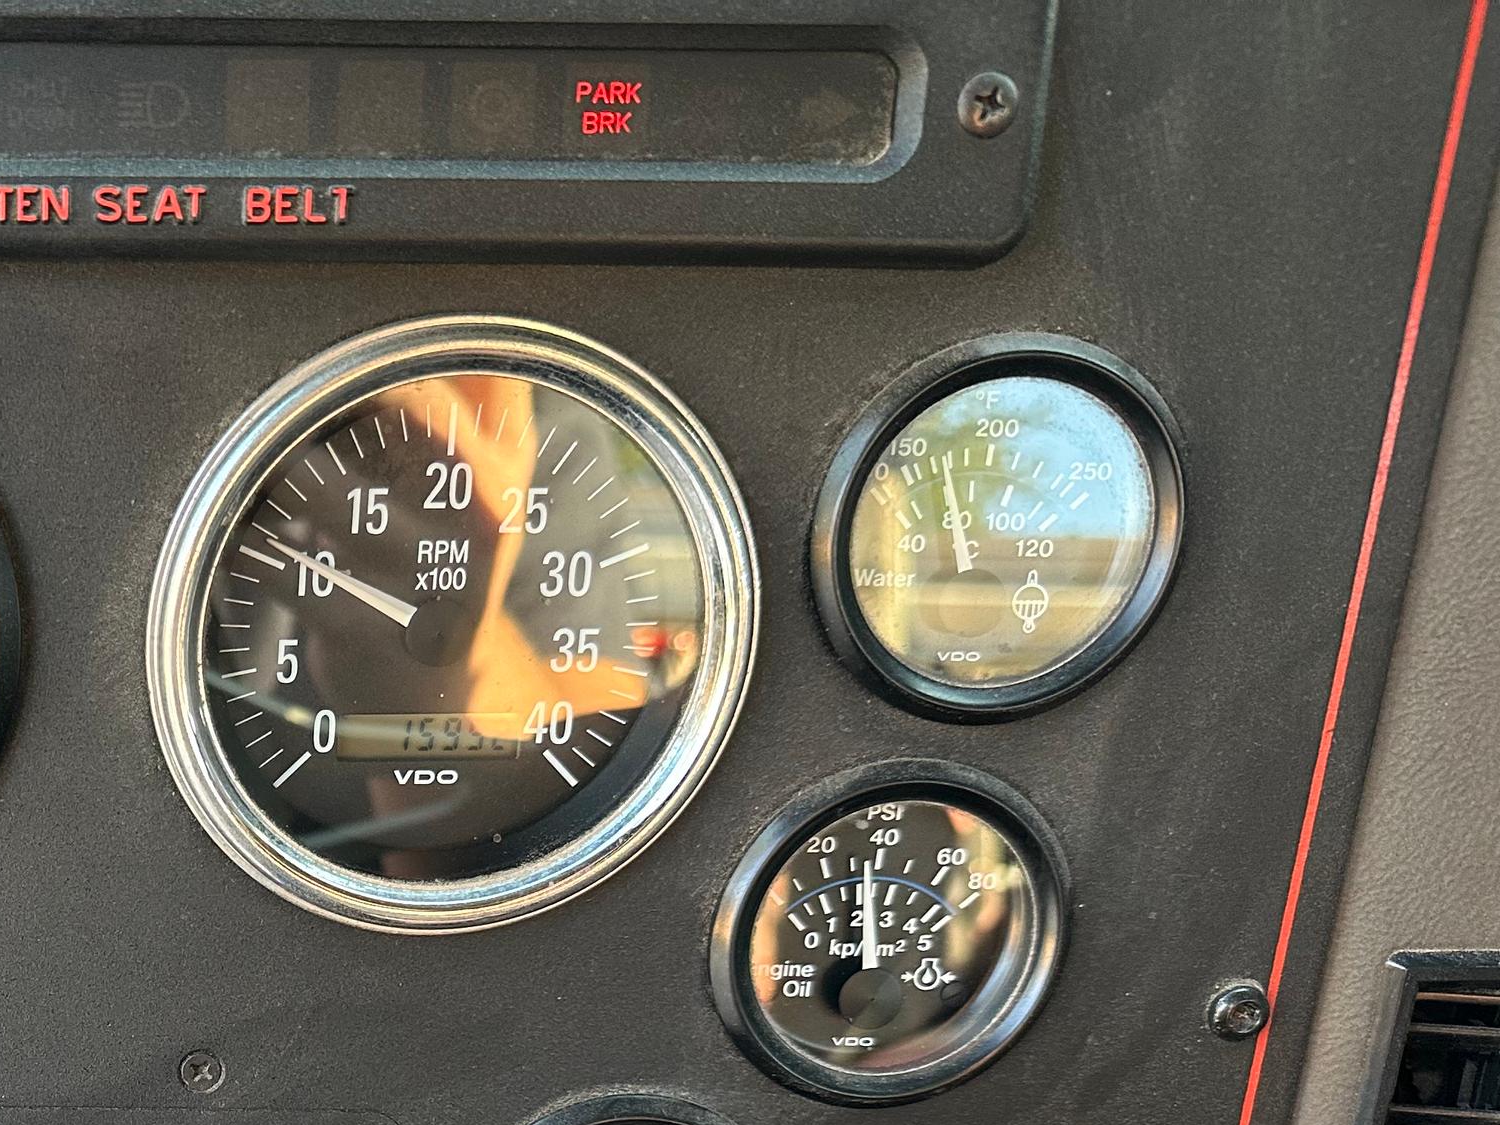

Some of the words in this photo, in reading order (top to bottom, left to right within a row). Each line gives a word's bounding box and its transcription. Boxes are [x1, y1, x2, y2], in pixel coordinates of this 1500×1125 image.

[575, 81, 642, 104] PARK
[581, 111, 632, 135] BRK
[94, 186, 206, 223] SEAT
[241, 186, 356, 224] BELT
[974, 419, 1020, 438] 200
[890, 438, 927, 457] 150
[1069, 462, 1113, 482] 250
[423, 462, 474, 510] 20
[346, 488, 389, 535] 15
[499, 488, 549, 534] 25
[941, 511, 973, 530] 80
[985, 512, 1026, 531] 100
[416, 540, 470, 565] RPM
[897, 534, 926, 553] 40
[1015, 539, 1054, 558] 120
[293, 551, 337, 597] 10
[414, 568, 467, 592] x100
[540, 552, 593, 598] 30
[854, 568, 916, 588] Water
[276, 639, 299, 684] 5
[549, 630, 600, 673] 35
[937, 651, 981, 662] VDO
[312, 708, 337, 752] 0
[523, 702, 574, 745] 40
[393, 769, 459, 785] VDO
[807, 836, 836, 854] 20
[870, 828, 899, 846] 40
[936, 848, 966, 866] 60
[967, 873, 998, 890] 80
[826, 916, 838, 933] 1
[849, 909, 863, 927] 2
[878, 910, 894, 928] 3
[902, 917, 919, 934] 4
[804, 933, 820, 949] 0
[916, 934, 933, 951] 5
[752, 960, 815, 981] ngine
[782, 980, 813, 998] Oil
[831, 1036, 874, 1047] VDO
